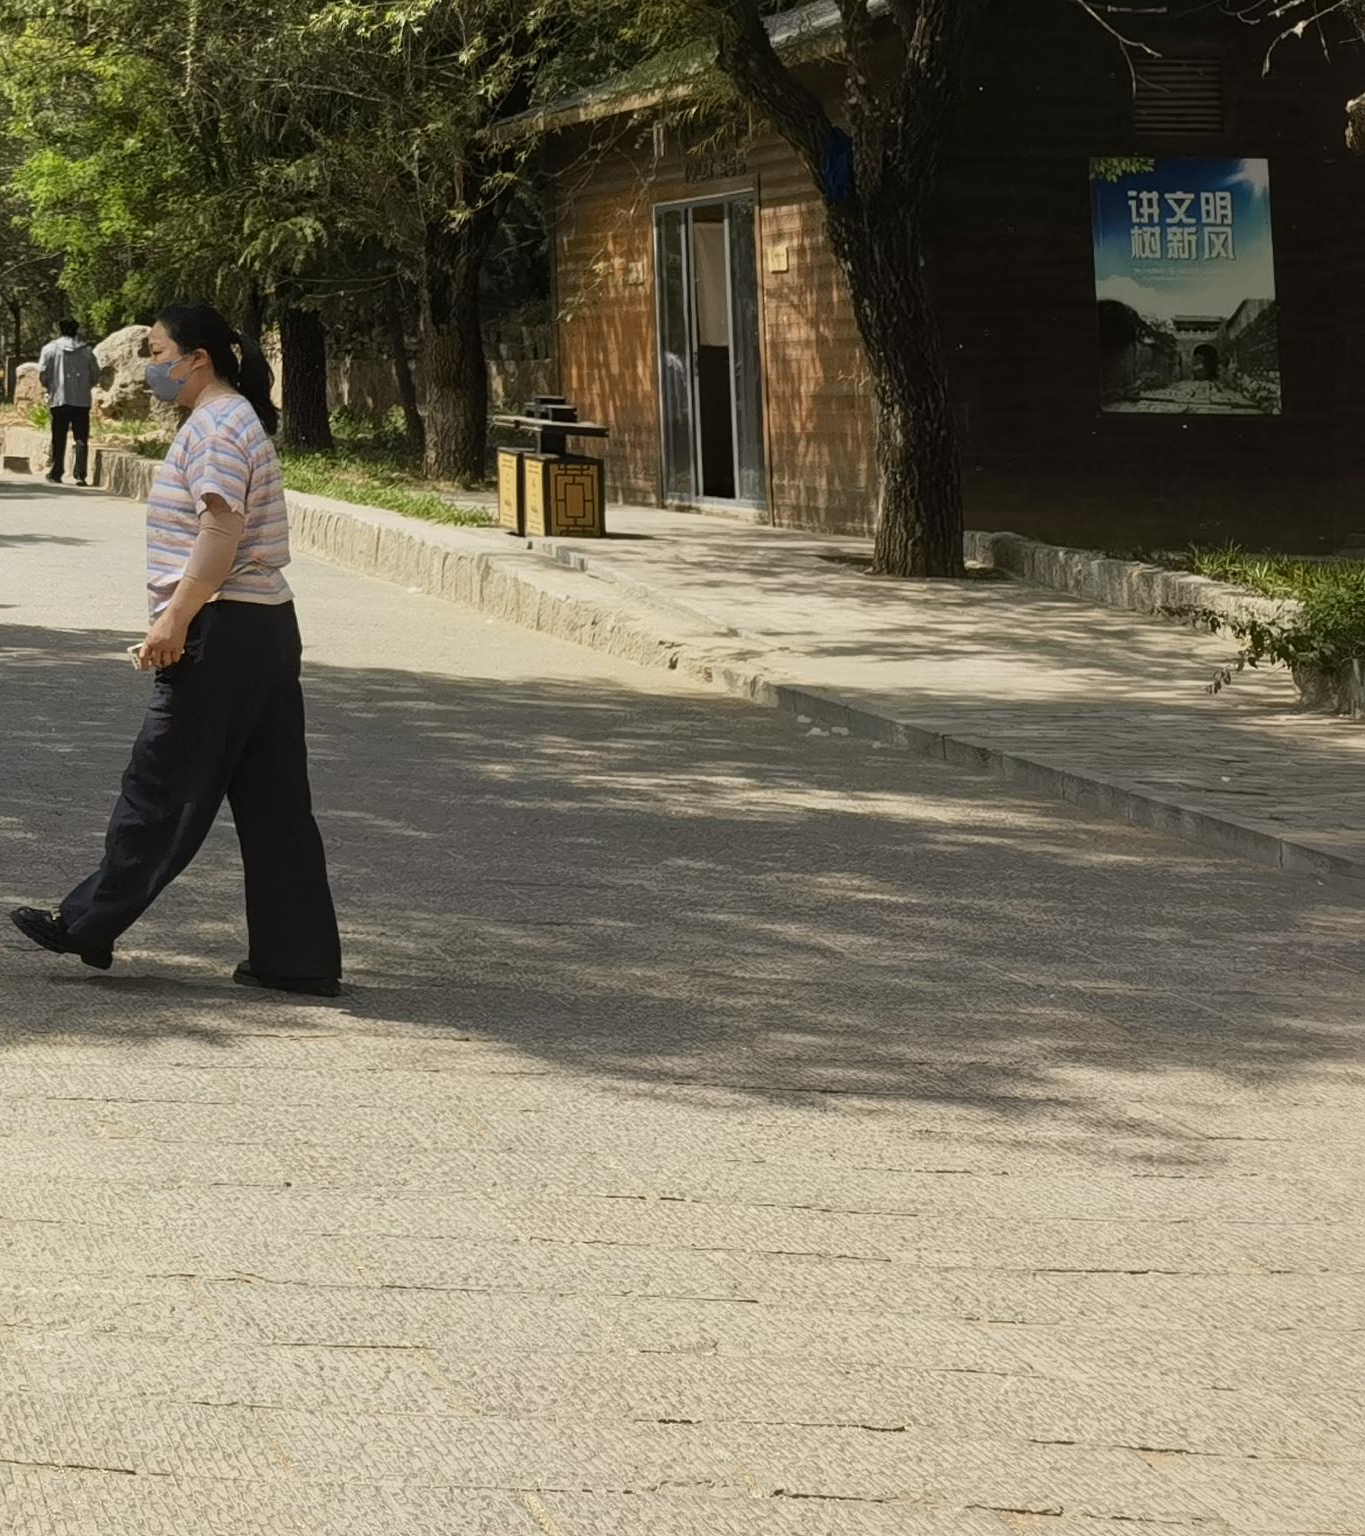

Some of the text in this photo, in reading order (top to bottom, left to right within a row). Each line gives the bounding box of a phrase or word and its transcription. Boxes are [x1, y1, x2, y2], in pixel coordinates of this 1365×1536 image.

[1127, 191, 1233, 225] 讲文明
[1130, 226, 1236, 260] 树新风
